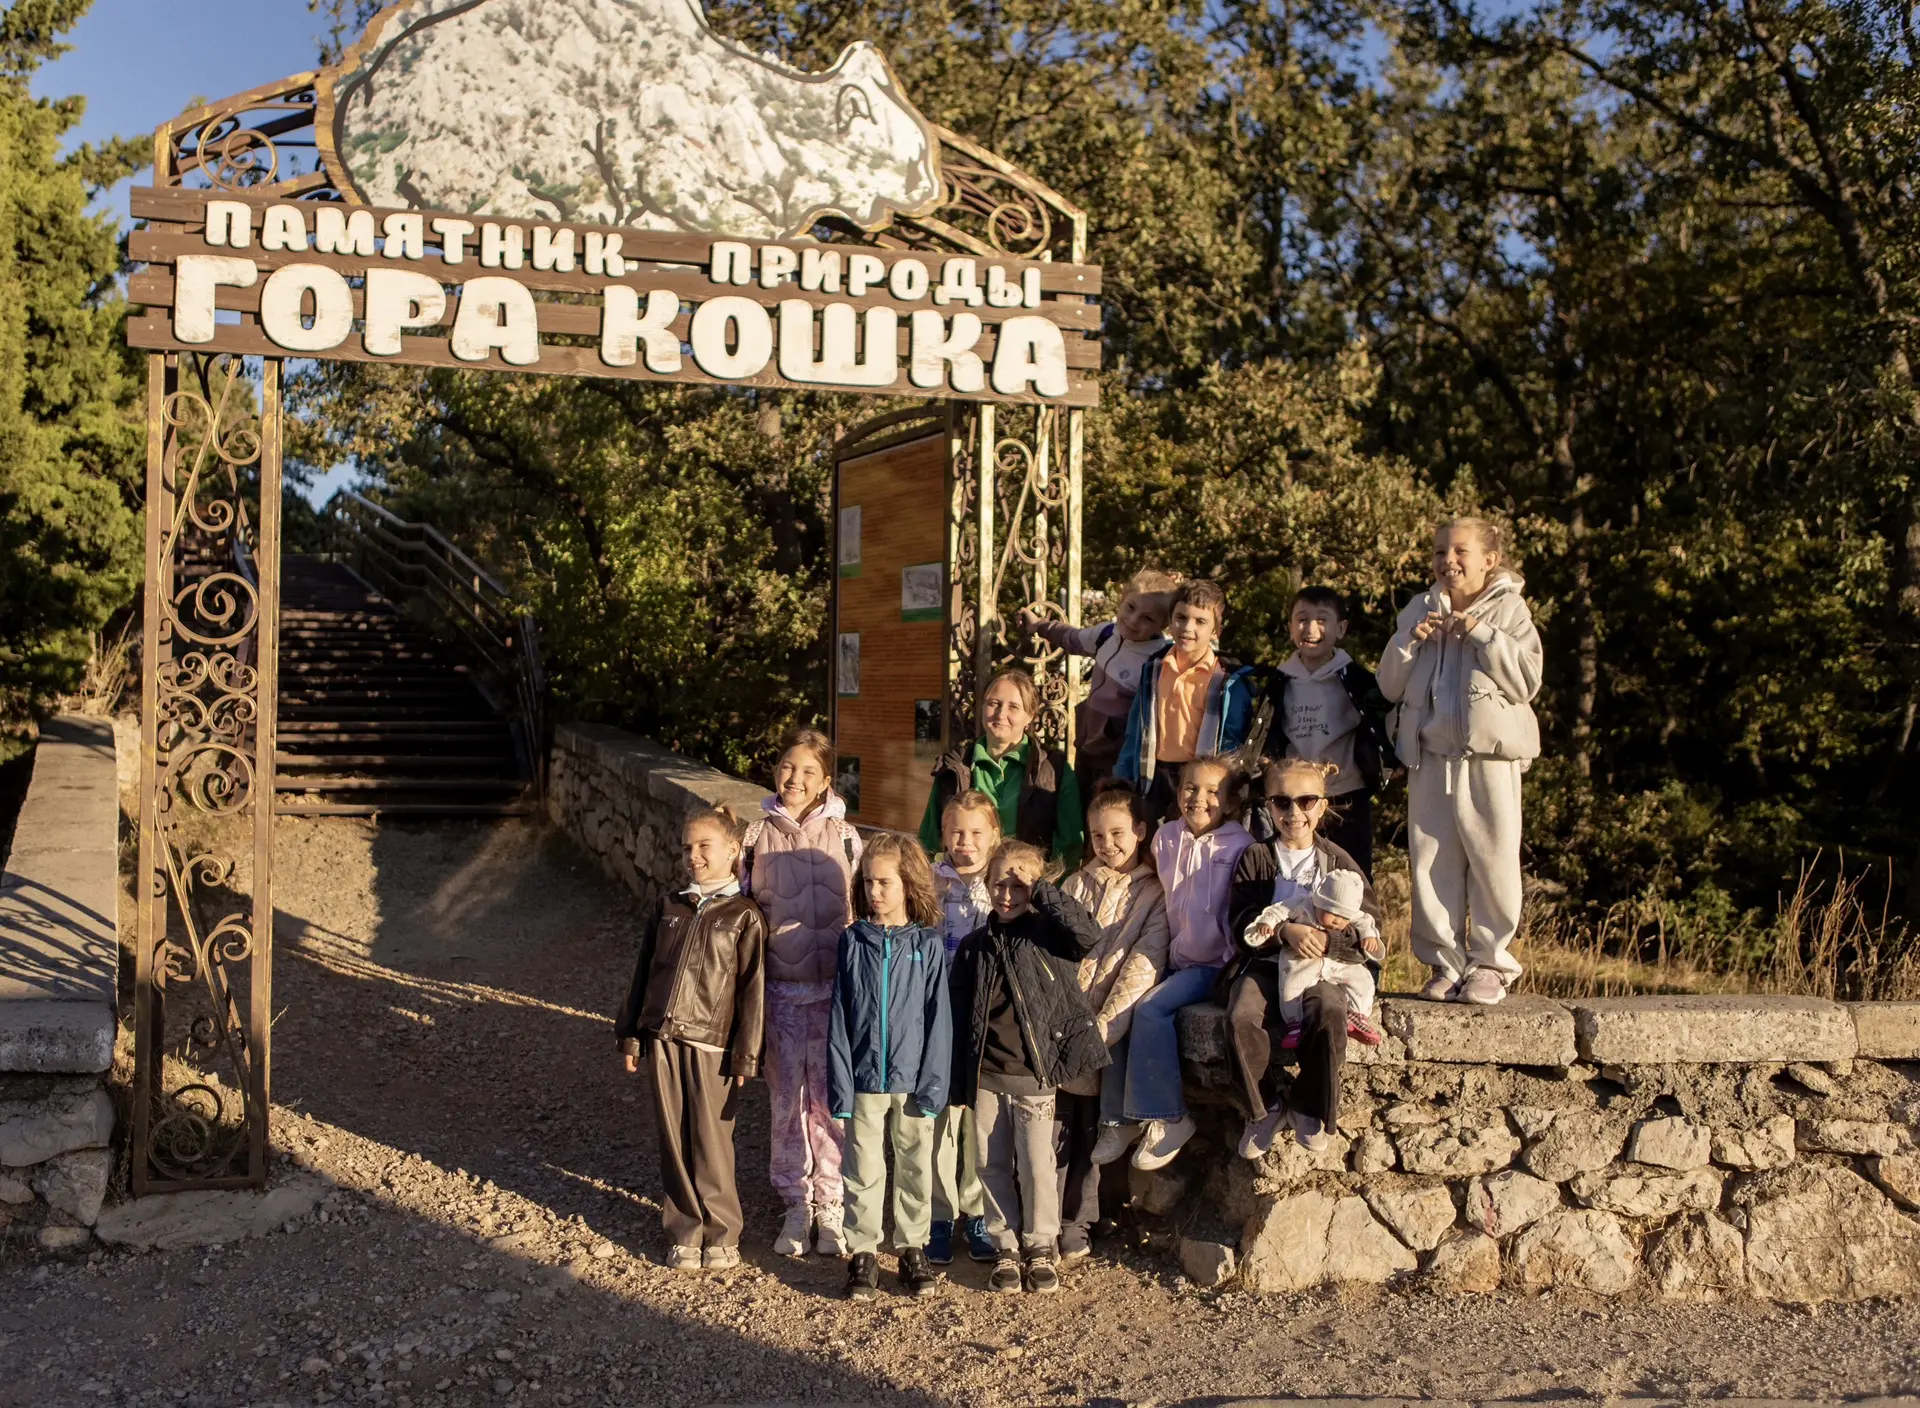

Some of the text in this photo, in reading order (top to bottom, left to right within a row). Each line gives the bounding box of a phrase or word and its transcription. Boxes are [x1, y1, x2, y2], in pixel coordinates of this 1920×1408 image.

[205, 200, 1042, 308] ПАМЯТНИК ПРИРОДЫ
[173, 254, 1069, 397] ГОРА КОШКА
